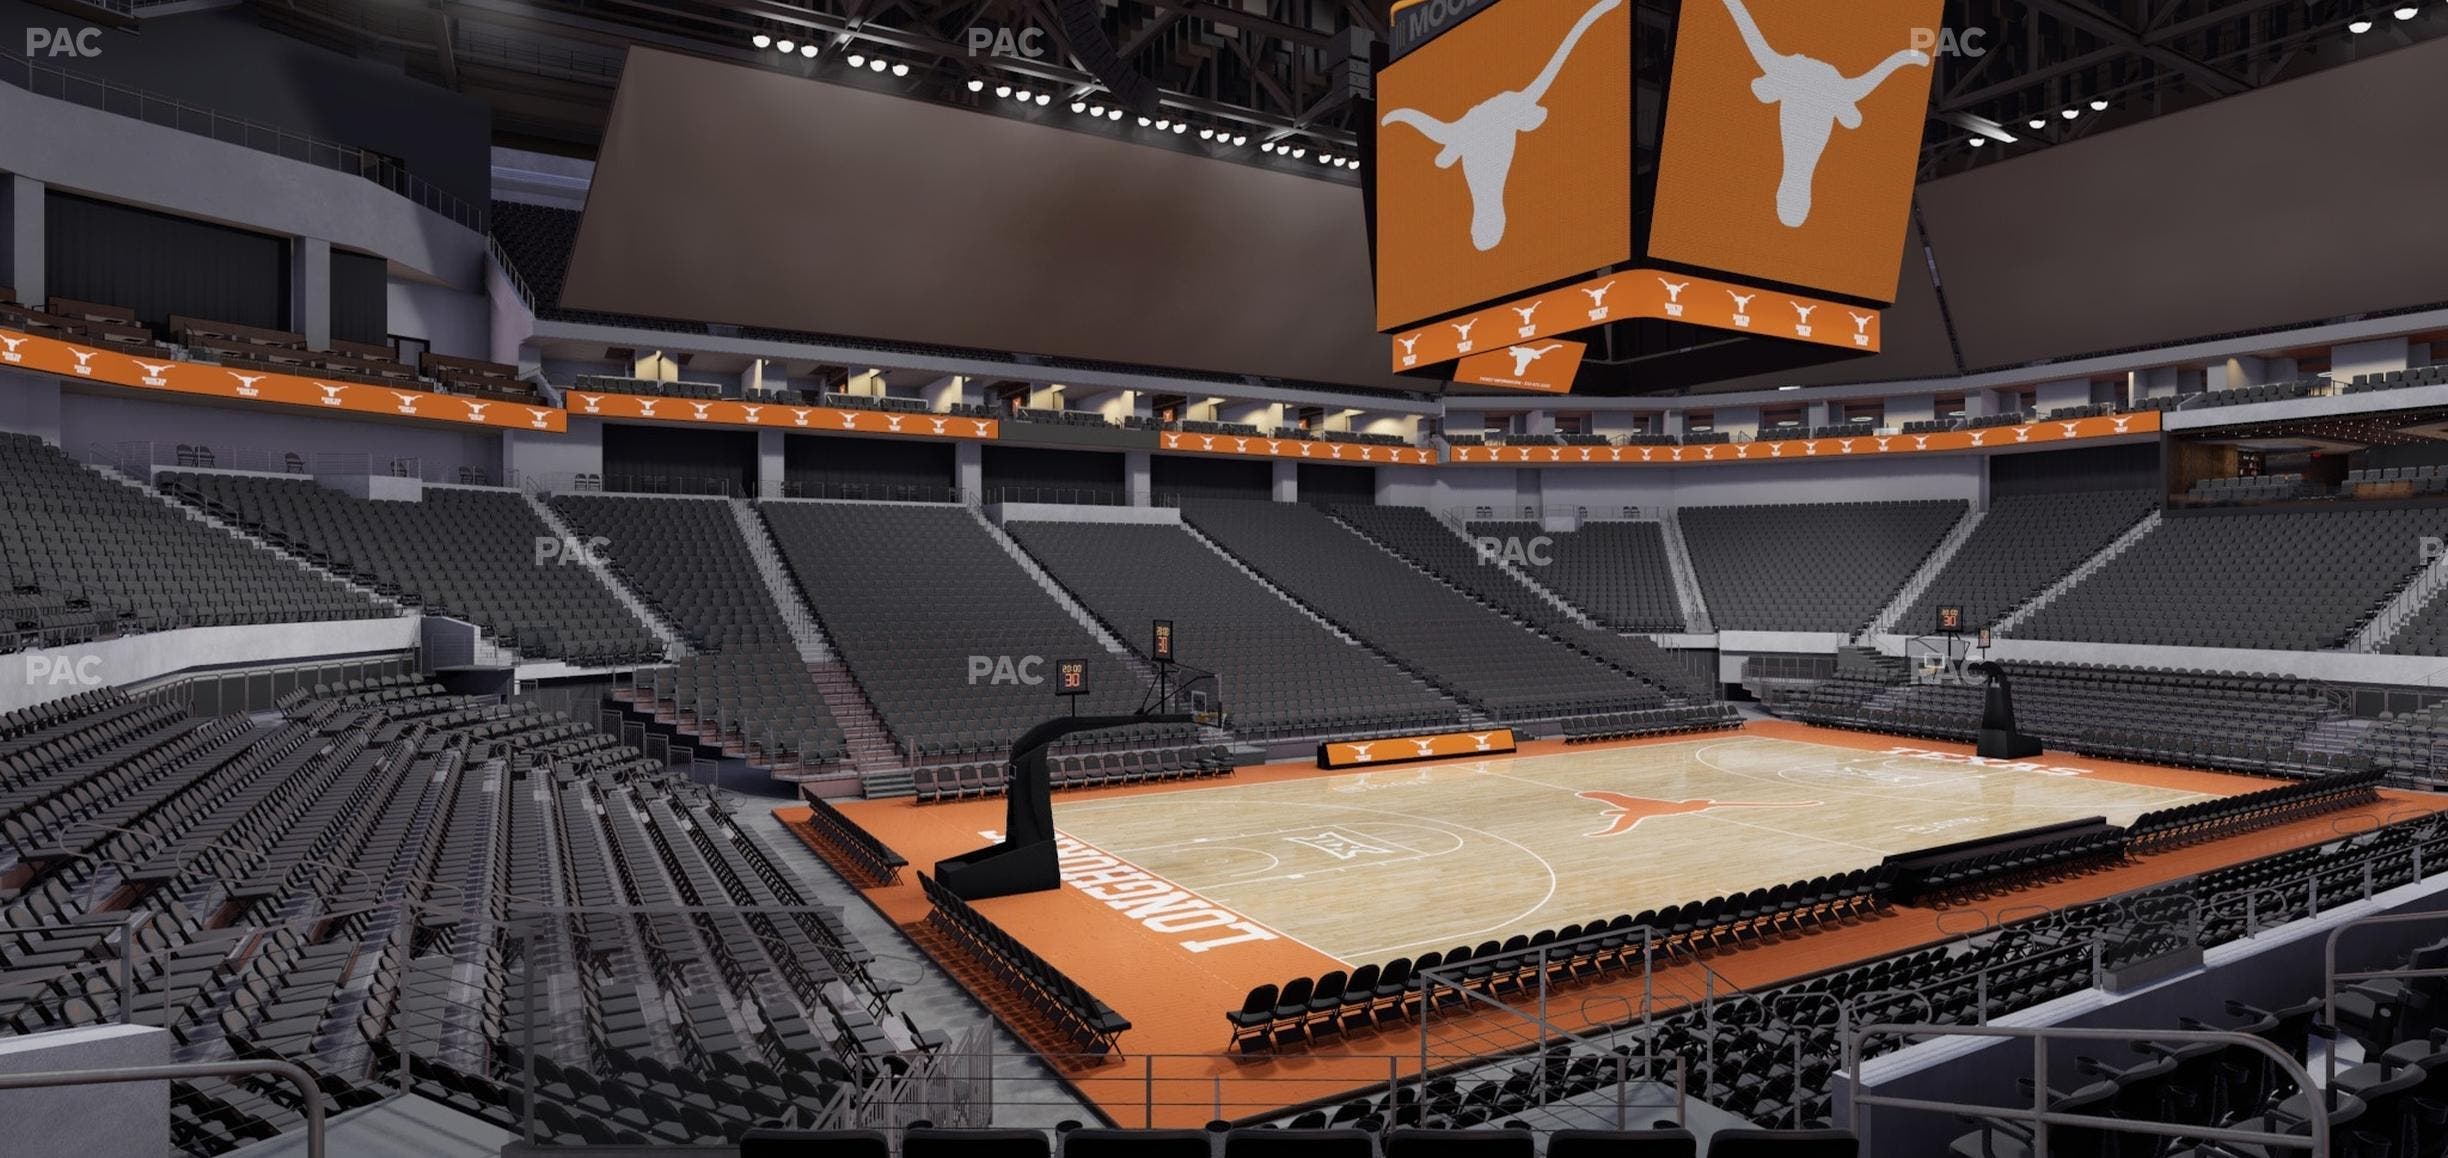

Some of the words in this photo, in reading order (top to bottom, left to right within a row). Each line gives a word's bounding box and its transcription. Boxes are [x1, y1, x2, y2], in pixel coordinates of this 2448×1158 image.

[1158, 636, 1168, 653] 30
[1062, 664, 1083, 673] 20:00
[1065, 673, 1081, 688] 30
[1881, 746, 2093, 777] TEXAS
